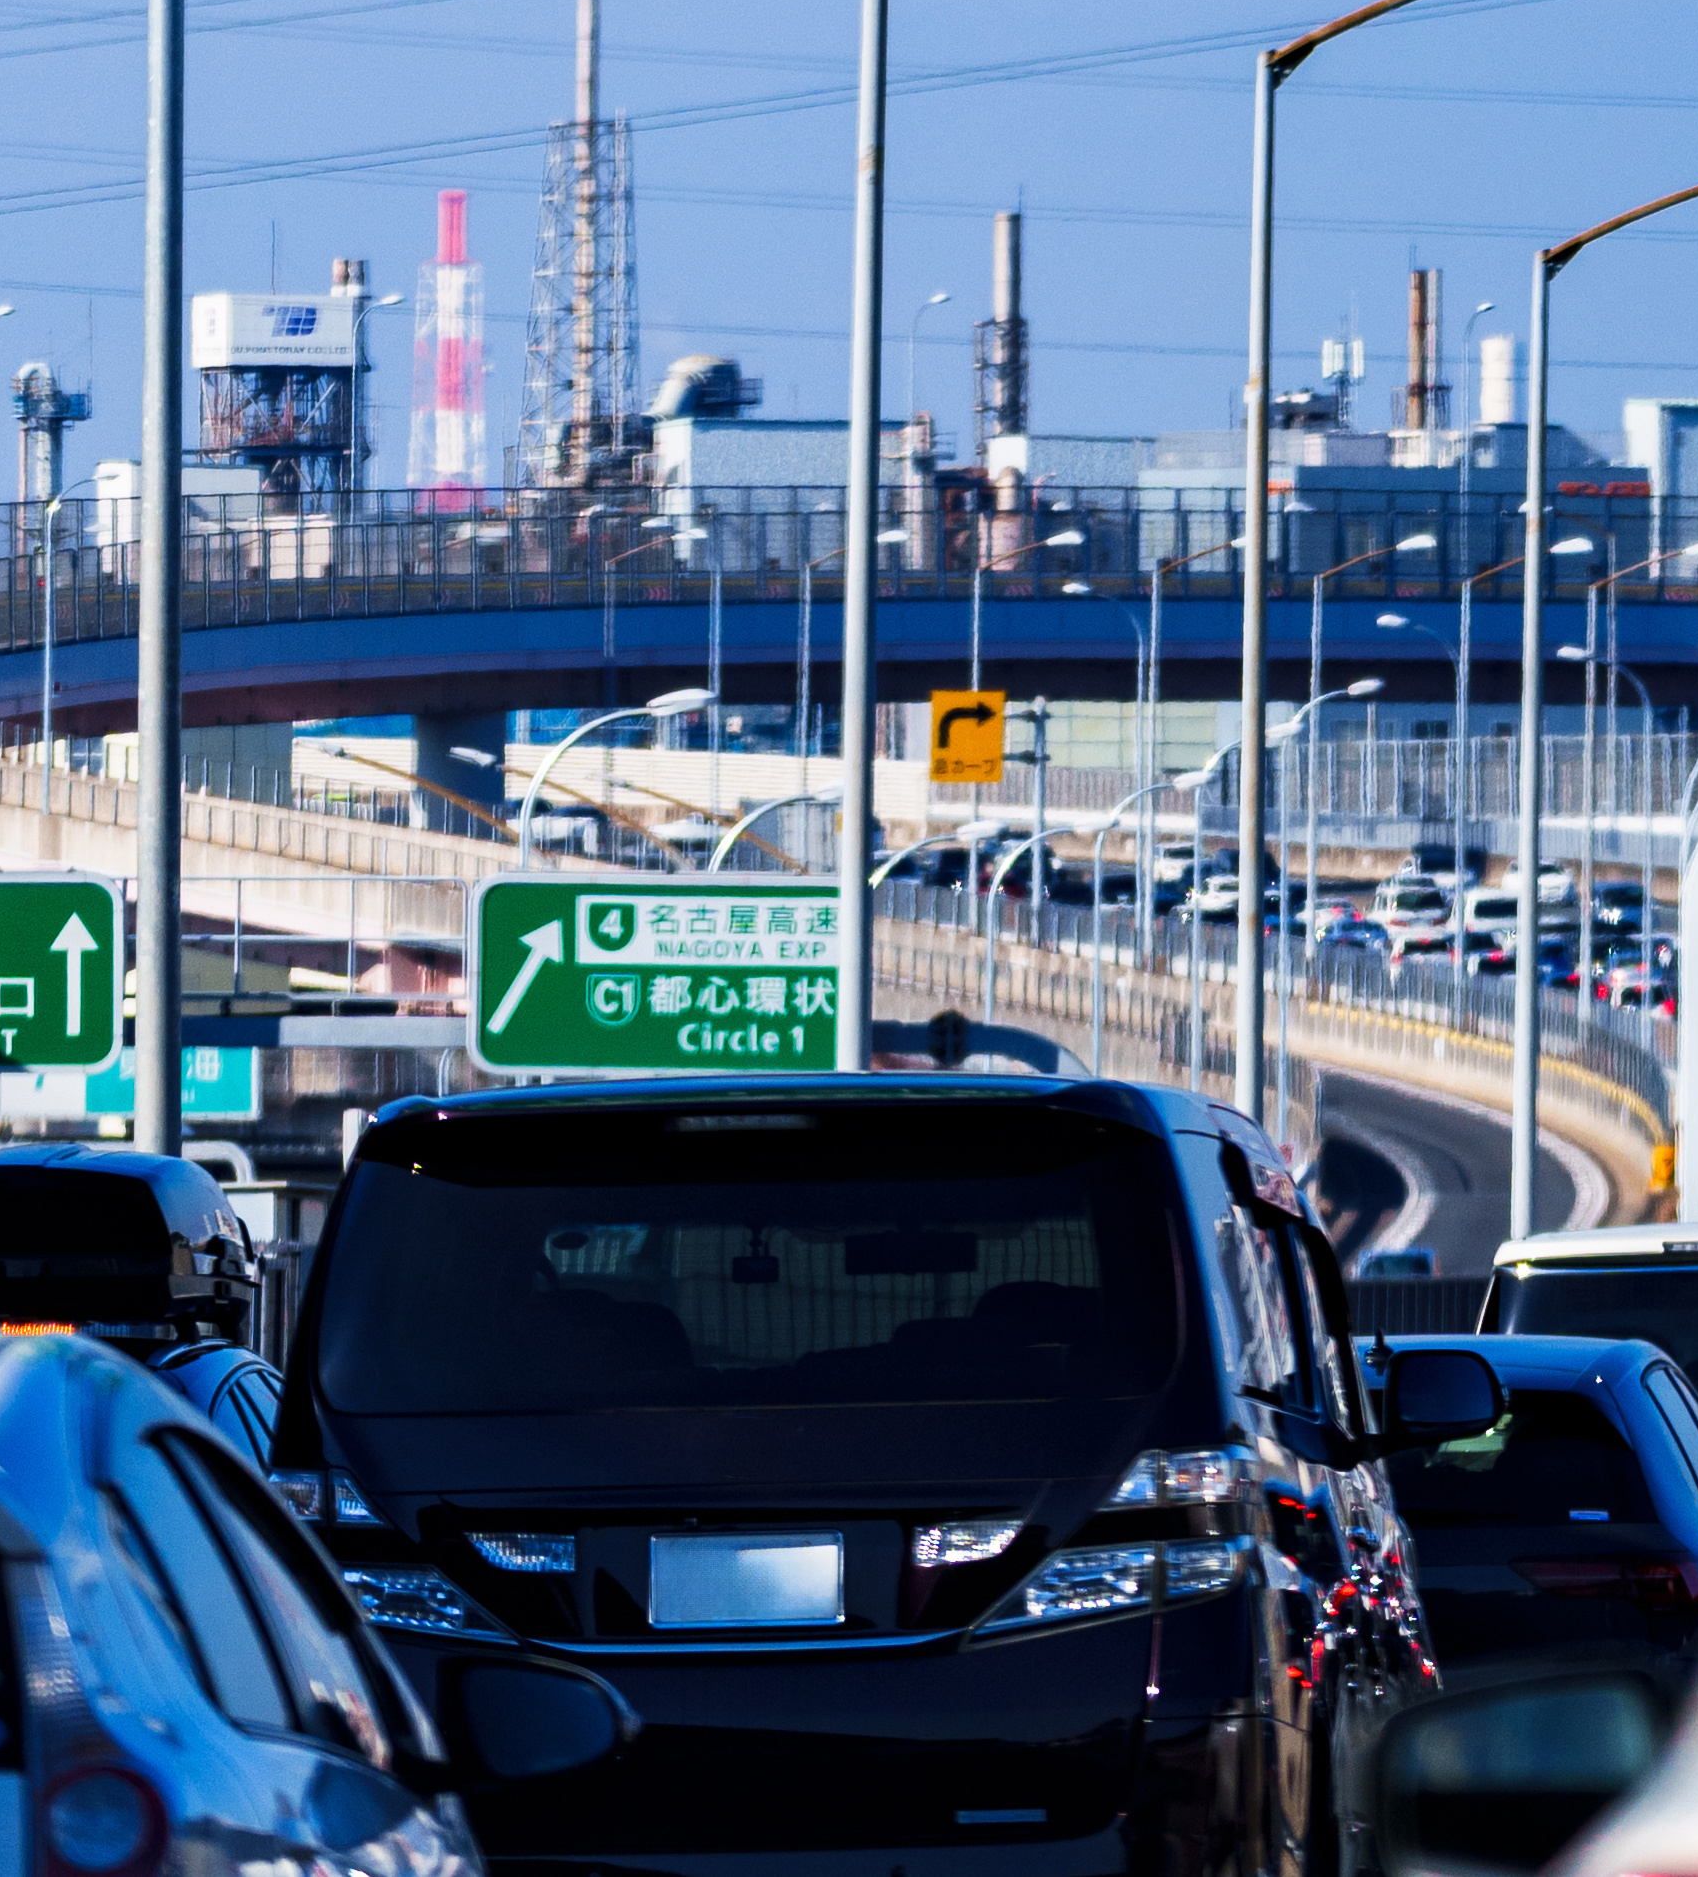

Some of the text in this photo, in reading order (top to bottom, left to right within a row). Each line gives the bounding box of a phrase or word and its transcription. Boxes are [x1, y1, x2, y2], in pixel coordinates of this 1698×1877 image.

[598, 908, 624, 939] 4
[647, 904, 840, 936] 名古屋高速
[655, 939, 826, 960] NAGOYA EXP
[592, 979, 635, 1015] C1
[647, 975, 835, 1017] 都心環状
[677, 1022, 805, 1054] Circle 1
